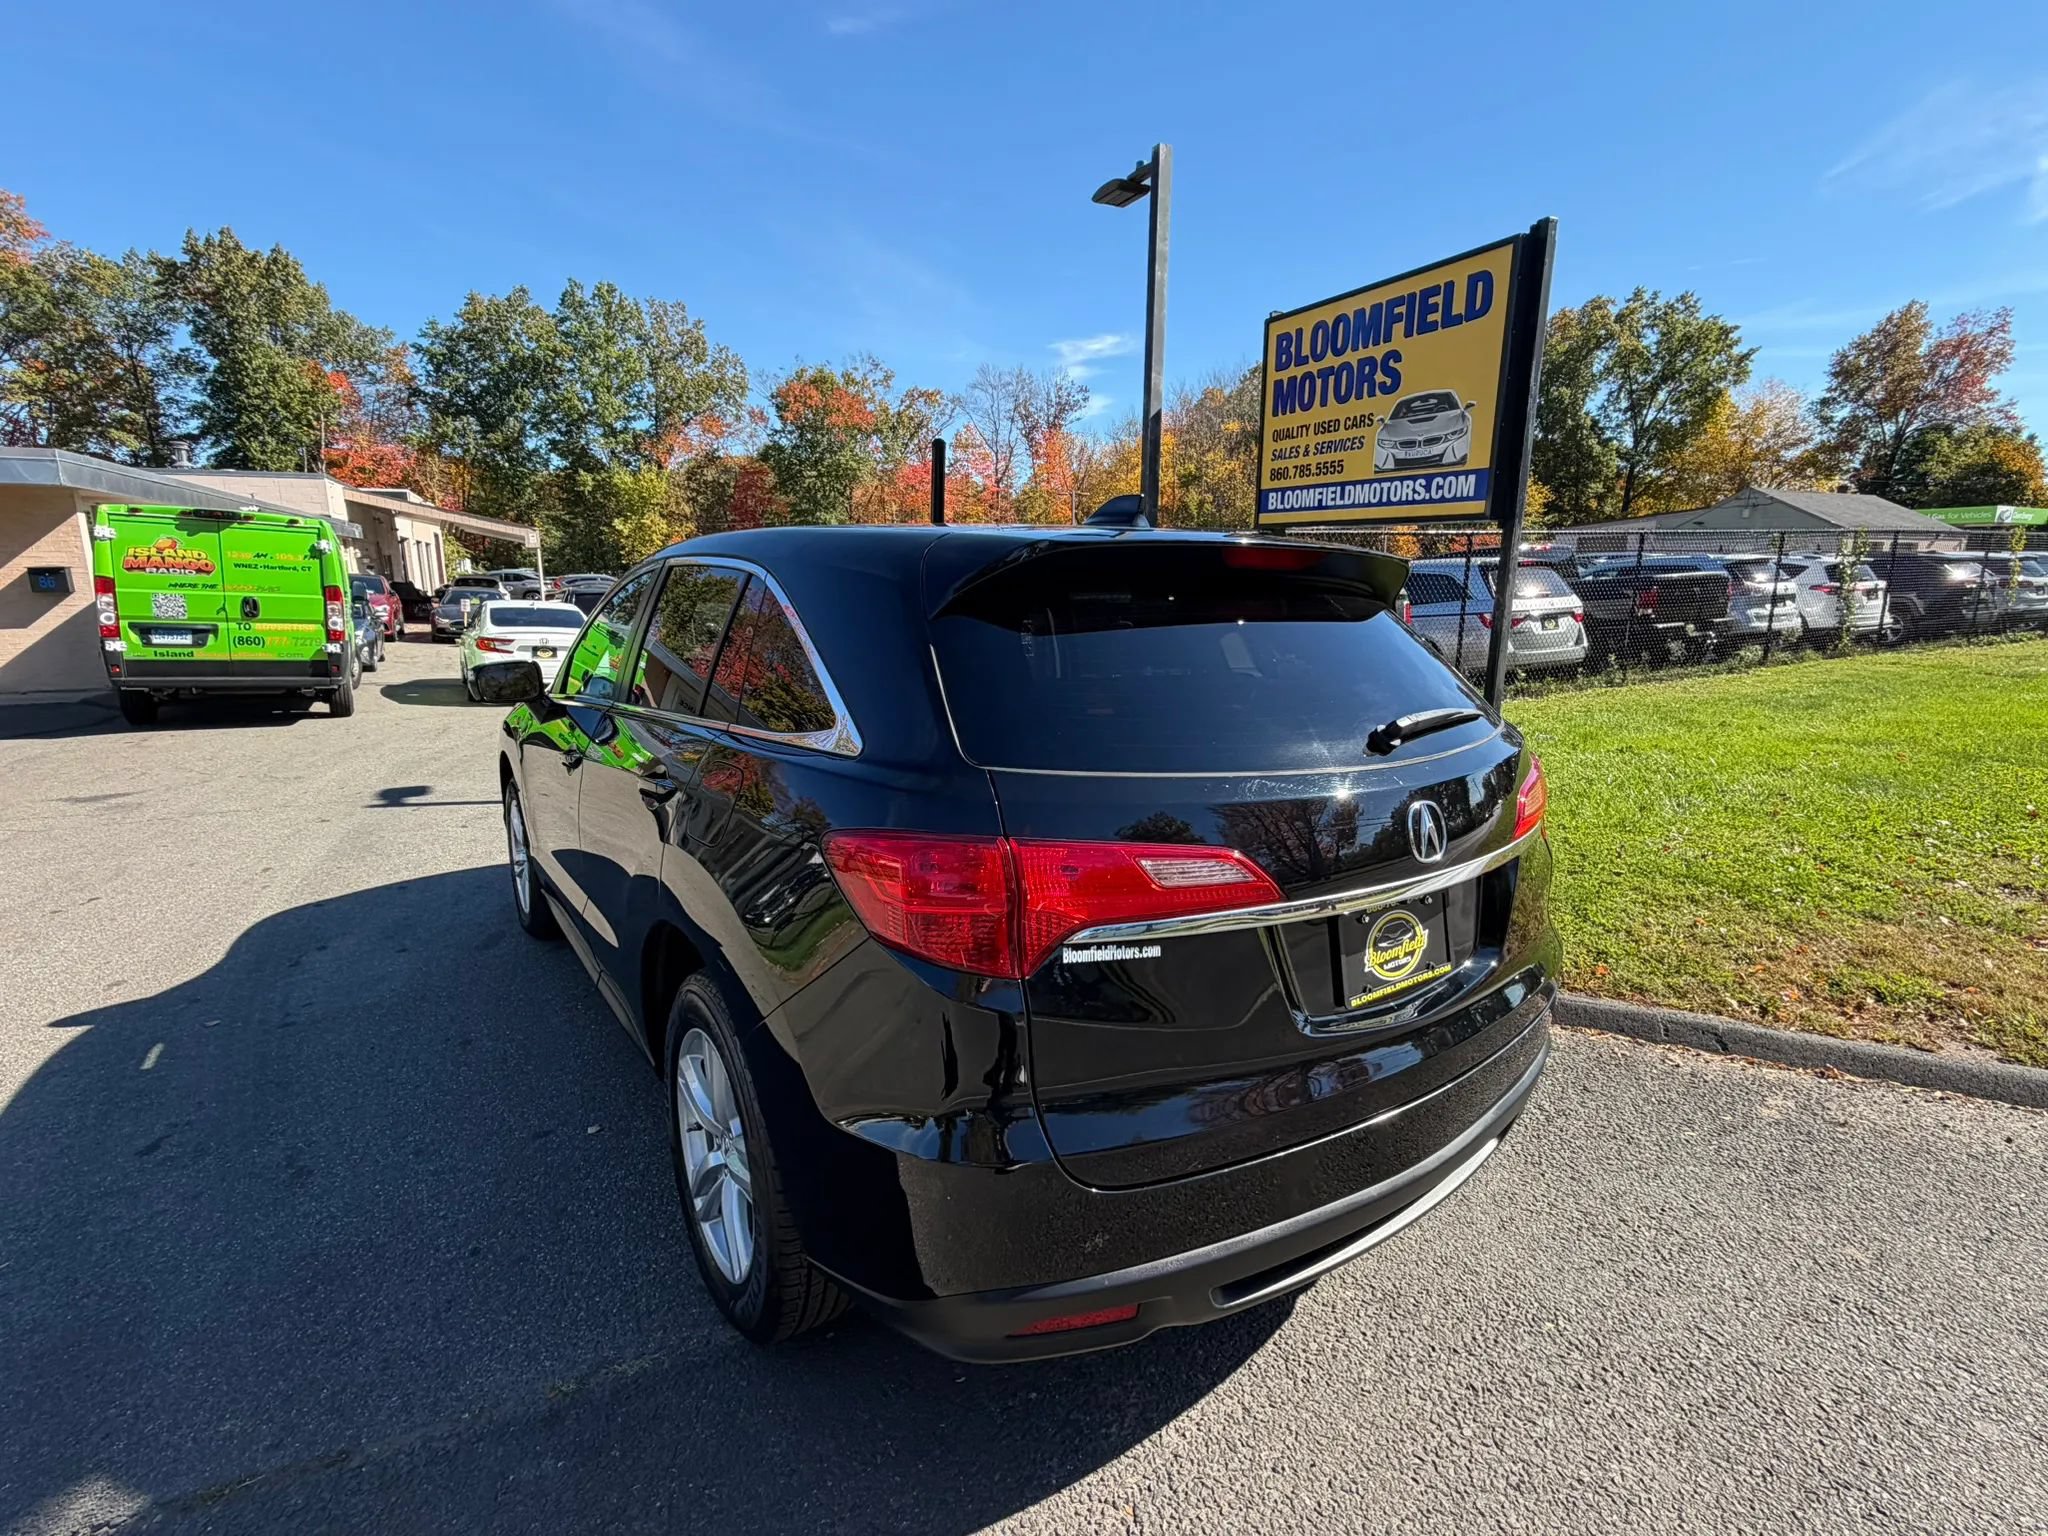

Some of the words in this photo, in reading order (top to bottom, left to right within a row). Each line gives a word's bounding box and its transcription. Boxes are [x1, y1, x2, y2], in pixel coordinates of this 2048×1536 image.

[1274, 270, 1494, 372] BLOOMFIELD
[1272, 349, 1403, 417] MOTORS
[1272, 424, 1311, 443] QUALITY
[1313, 418, 1340, 435] USED
[1343, 412, 1375, 430] CARS
[1271, 443, 1301, 462] SALES
[1302, 442, 1311, 457] &
[1313, 435, 1366, 456] SERVICES
[1270, 459, 1345, 482] 860.785.5555
[1268, 474, 1476, 511] BLOOMFIELDMOTORS.COM
[127, 547, 208, 560] ISLAND
[124, 557, 216, 572] MANGO
[145, 568, 197, 576] RADIO
[168, 582, 199, 590] WHERE
[236, 622, 251, 631] TO
[233, 636, 265, 648] (860)
[153, 650, 195, 658] Island
[1062, 945, 1161, 964] BloomfieldMotors.com
[1368, 934, 1425, 967] Bloomfield
[1351, 964, 1452, 1008] BLOOMFIELDMOTORS.COM
